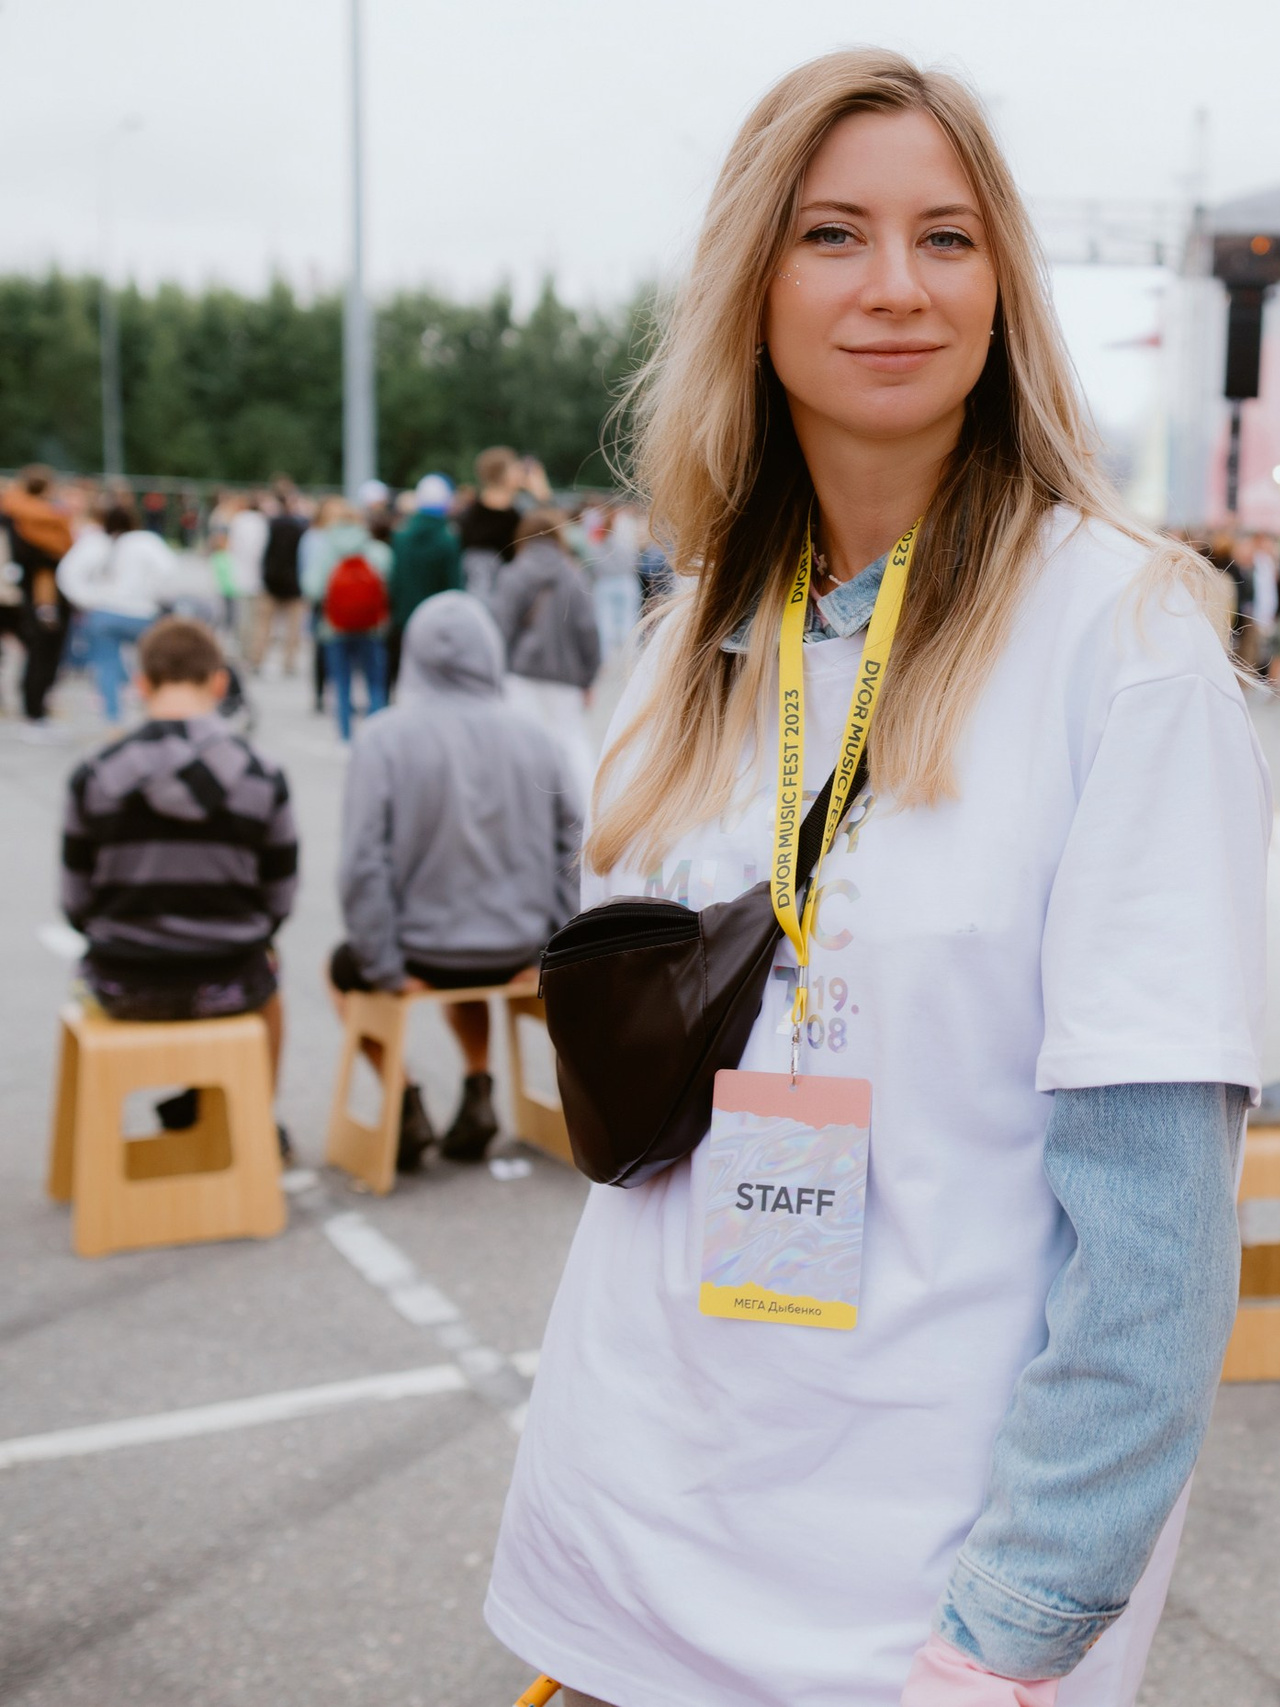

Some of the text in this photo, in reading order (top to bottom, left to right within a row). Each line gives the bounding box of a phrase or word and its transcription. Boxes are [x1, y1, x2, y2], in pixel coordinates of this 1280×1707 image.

[853, 660, 881, 720] DVOR
[837, 723, 864, 791] MUSIC
[776, 689, 799, 909] DVOR MUSIC FEST 2023
[812, 975, 859, 1014] 19.
[806, 1013, 848, 1054] 08
[735, 1182, 836, 1216] STAFF
[734, 1298, 822, 1316] МЕГА Дыбенко
